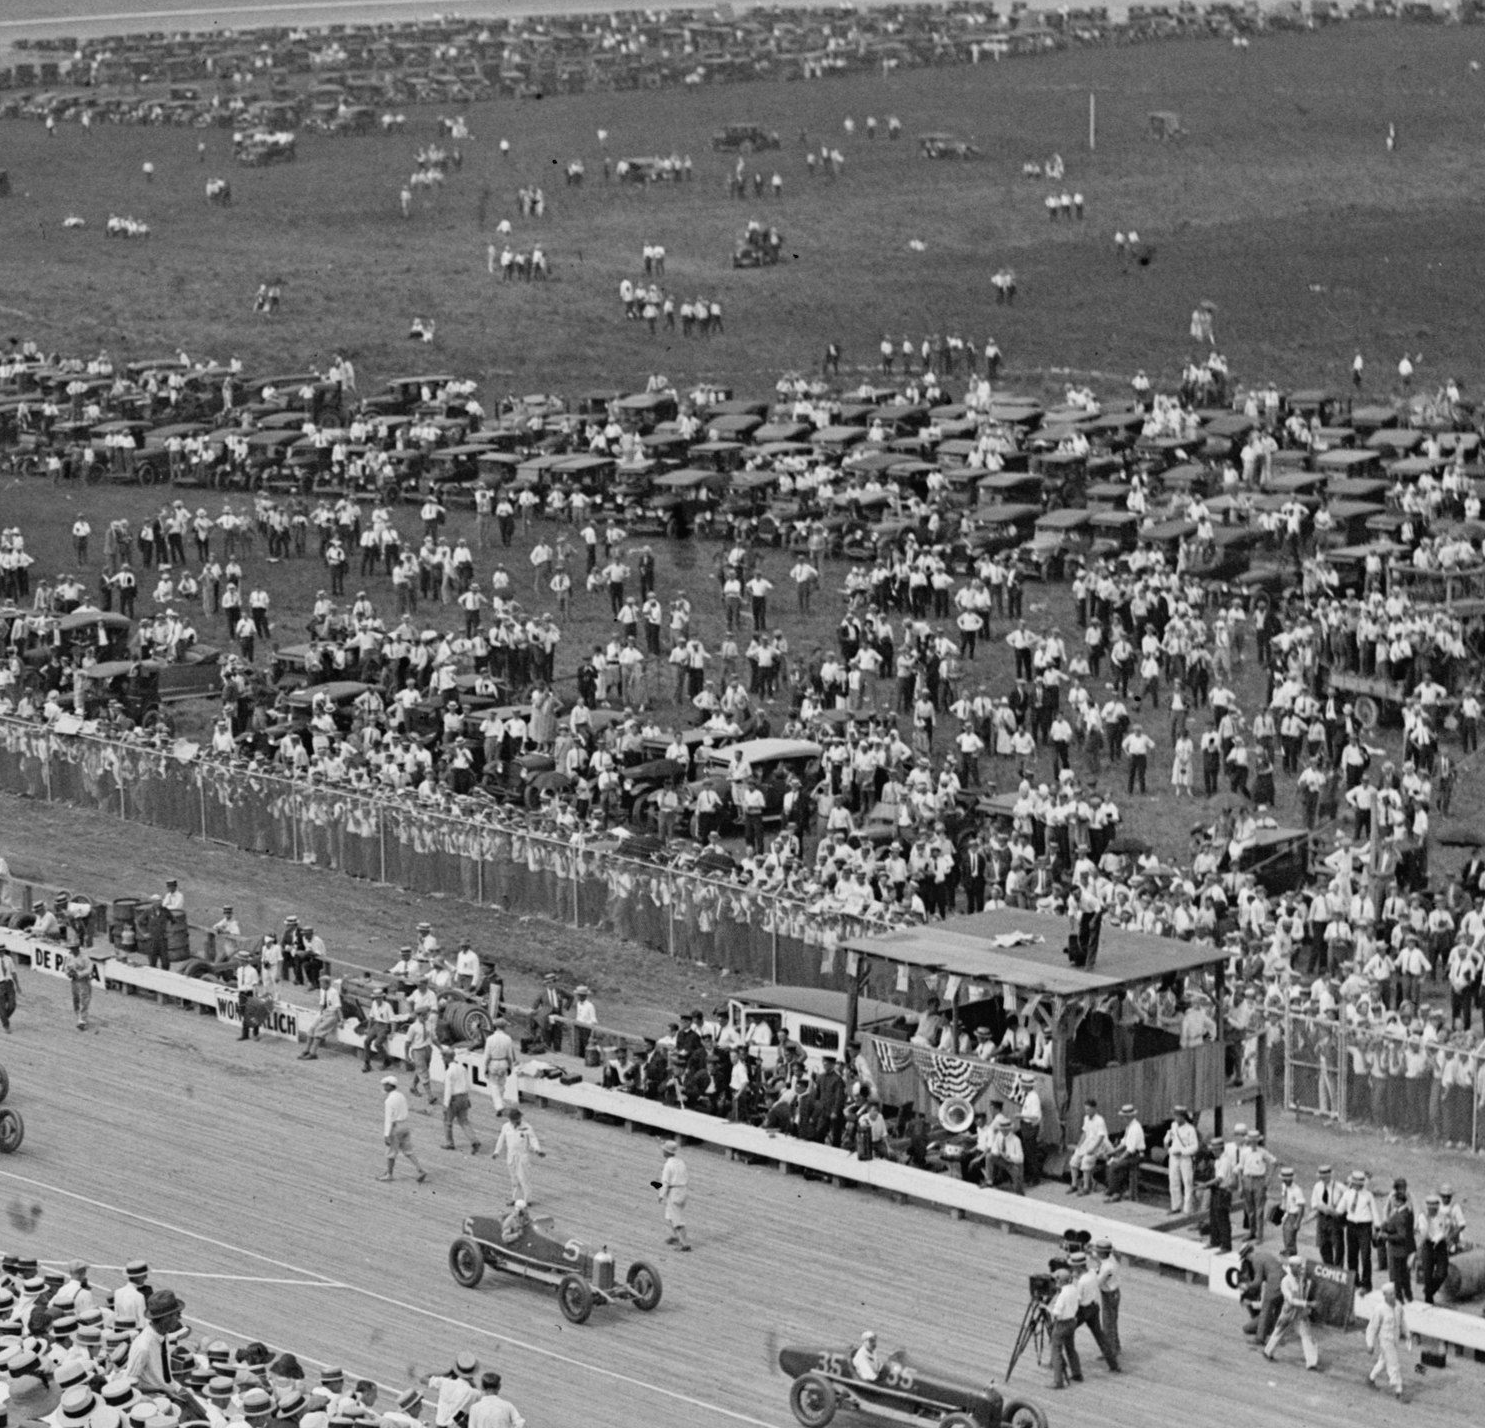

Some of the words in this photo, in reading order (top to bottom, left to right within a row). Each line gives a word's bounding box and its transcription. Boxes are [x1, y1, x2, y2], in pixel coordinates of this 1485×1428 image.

[35, 947, 51, 970] DE
[217, 997, 297, 1036] WONLICH
[562, 1239, 584, 1262] 5
[816, 1351, 846, 1377] 35
[886, 1360, 918, 1390] 35
